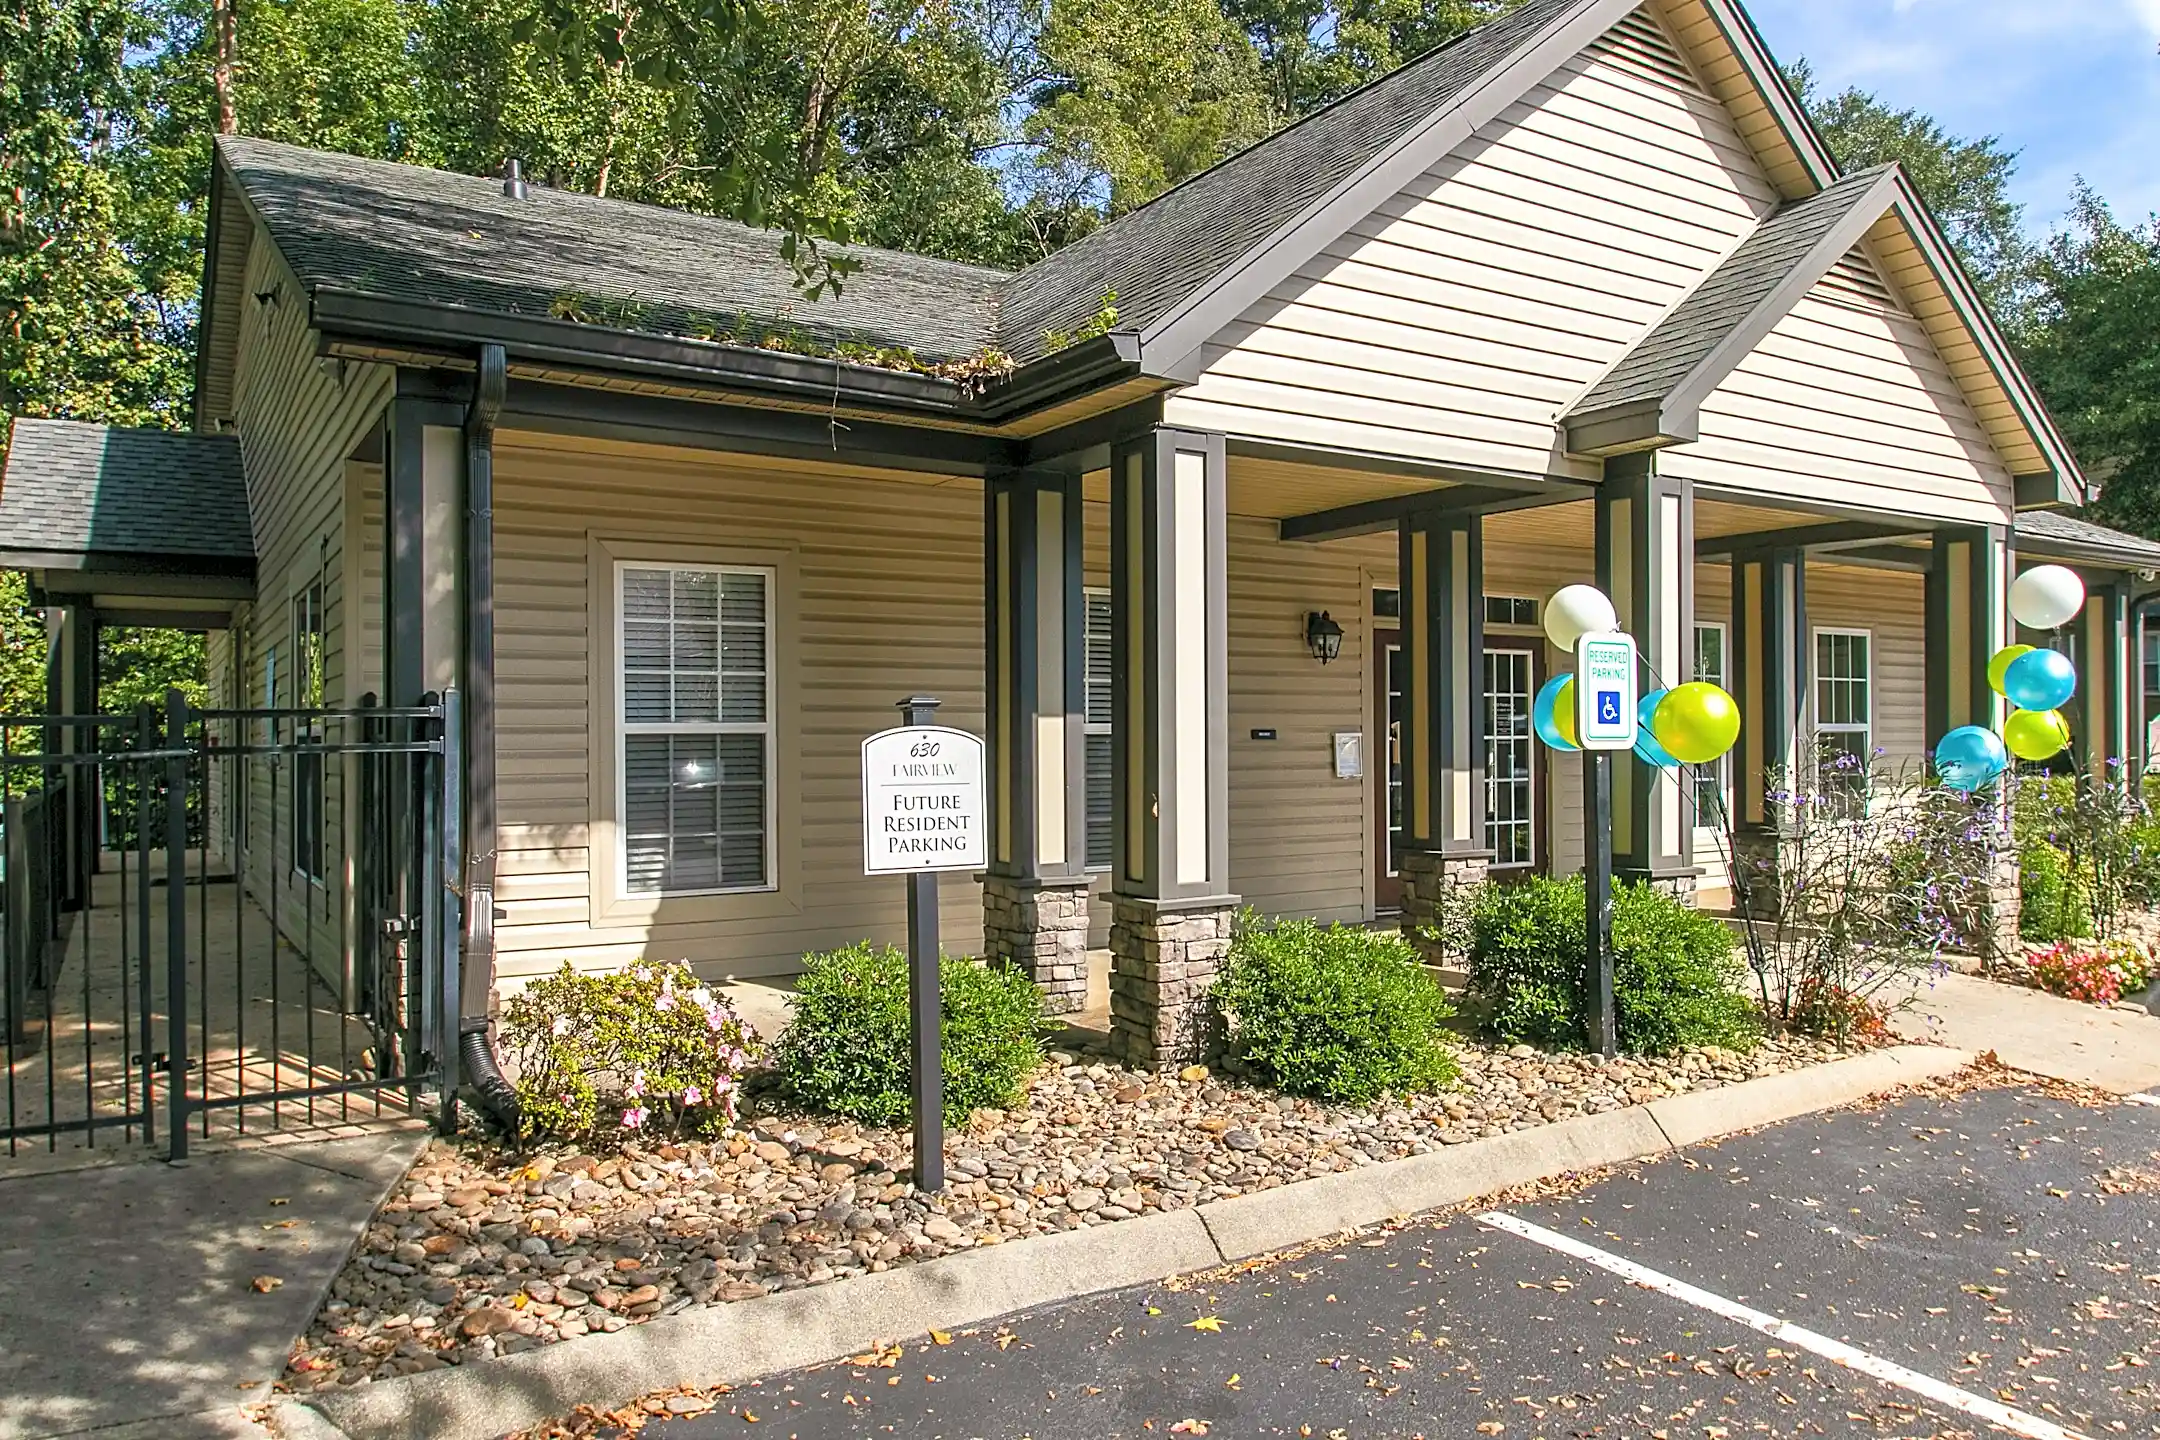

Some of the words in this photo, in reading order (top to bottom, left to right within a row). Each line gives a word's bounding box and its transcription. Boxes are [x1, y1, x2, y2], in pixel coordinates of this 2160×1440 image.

[1589, 650, 1628, 664] RESERVED
[1592, 667, 1626, 680] PARKING
[910, 742, 941, 758] 630
[893, 794, 961, 811] FUTURE
[884, 815, 971, 832] RESIDENT
[889, 836, 967, 853] PARKING
